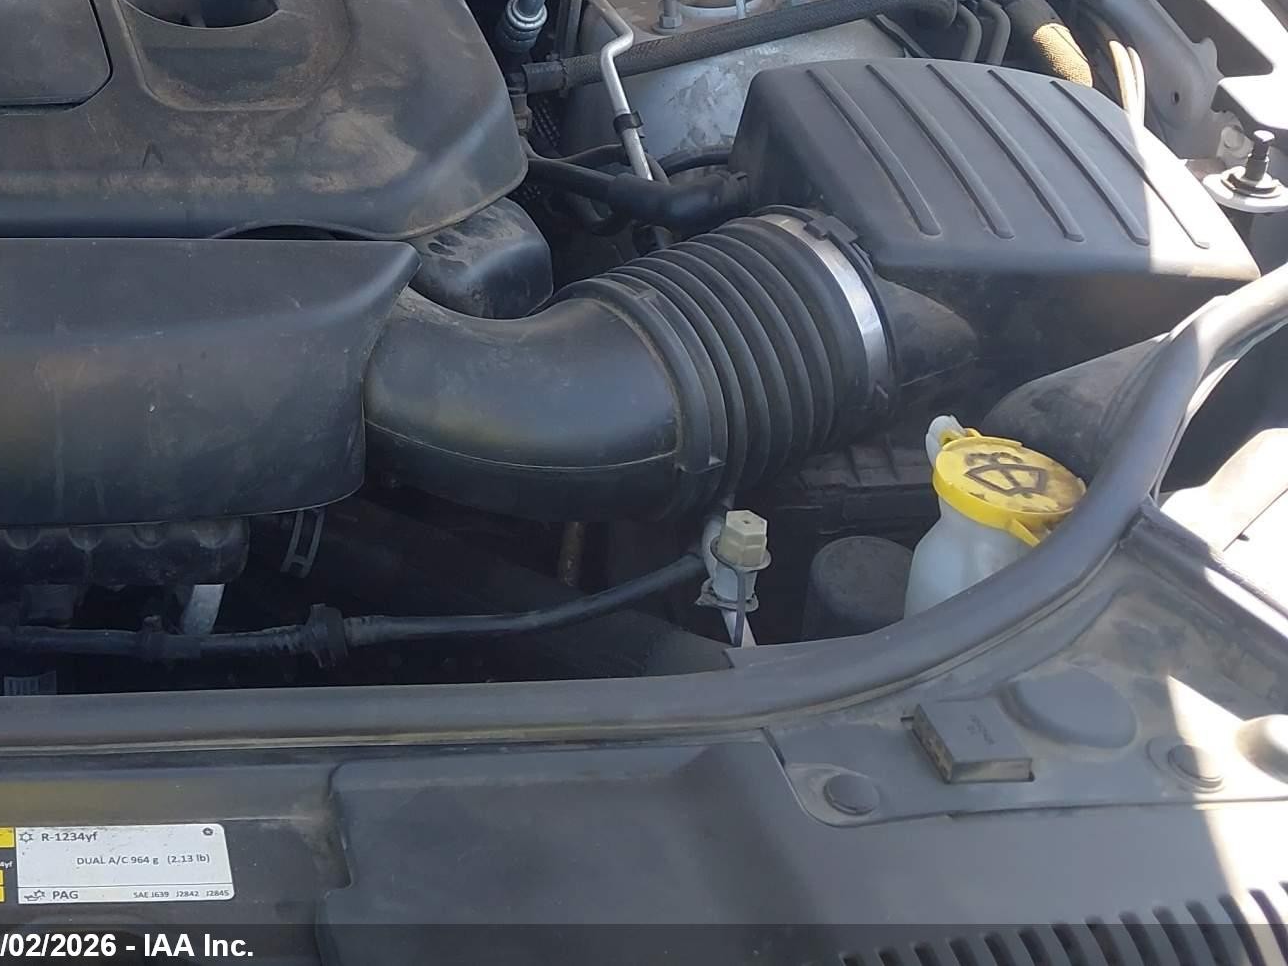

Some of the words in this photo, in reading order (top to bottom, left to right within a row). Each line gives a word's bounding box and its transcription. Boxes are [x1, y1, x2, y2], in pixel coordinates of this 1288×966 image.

[41, 831, 97, 843] R-1234yf
[77, 856, 106, 865] DUAL
[109, 856, 129, 865] A/C
[131, 856, 150, 865] 964
[167, 854, 193, 865] (2.13
[196, 853, 210, 865] lb)
[52, 890, 79, 900] PAG
